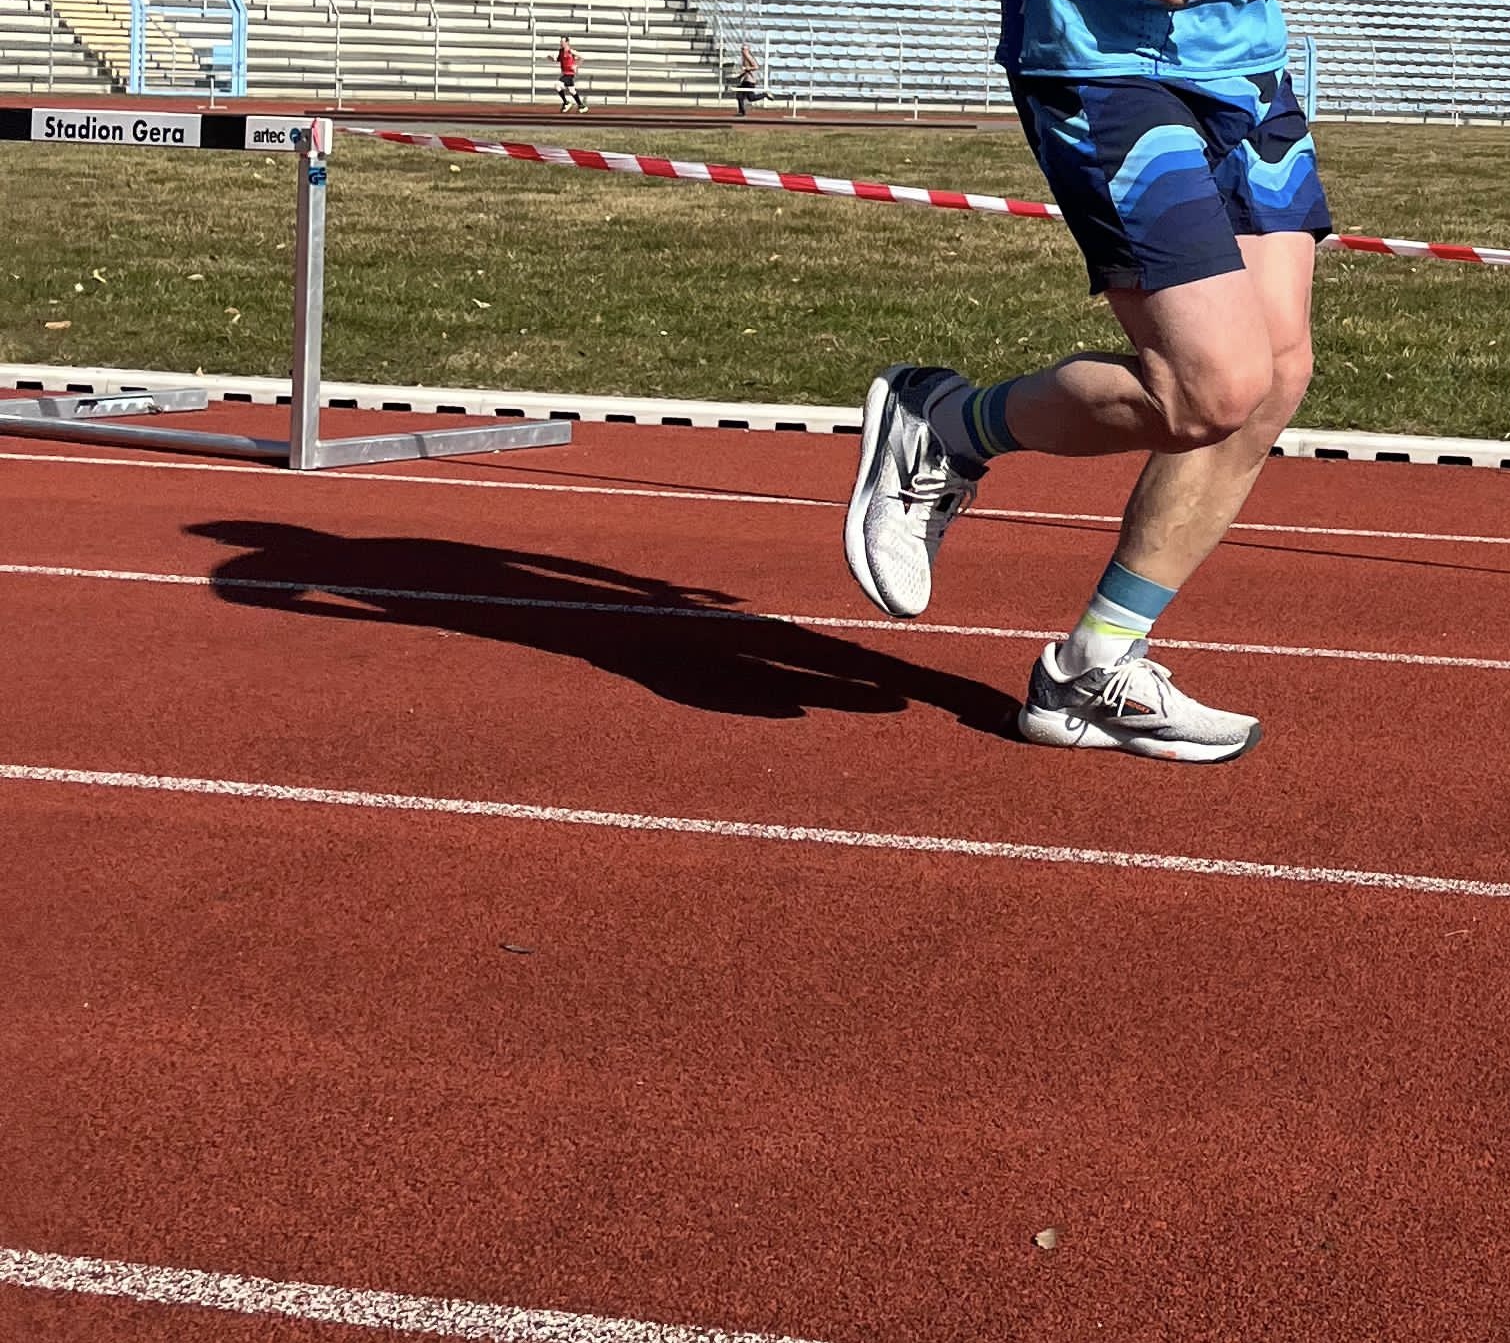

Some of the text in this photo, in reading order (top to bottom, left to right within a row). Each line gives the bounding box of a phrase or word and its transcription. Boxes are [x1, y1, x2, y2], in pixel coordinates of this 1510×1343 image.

[44, 116, 185, 144] Stadion Gera
[253, 127, 286, 144] artec
